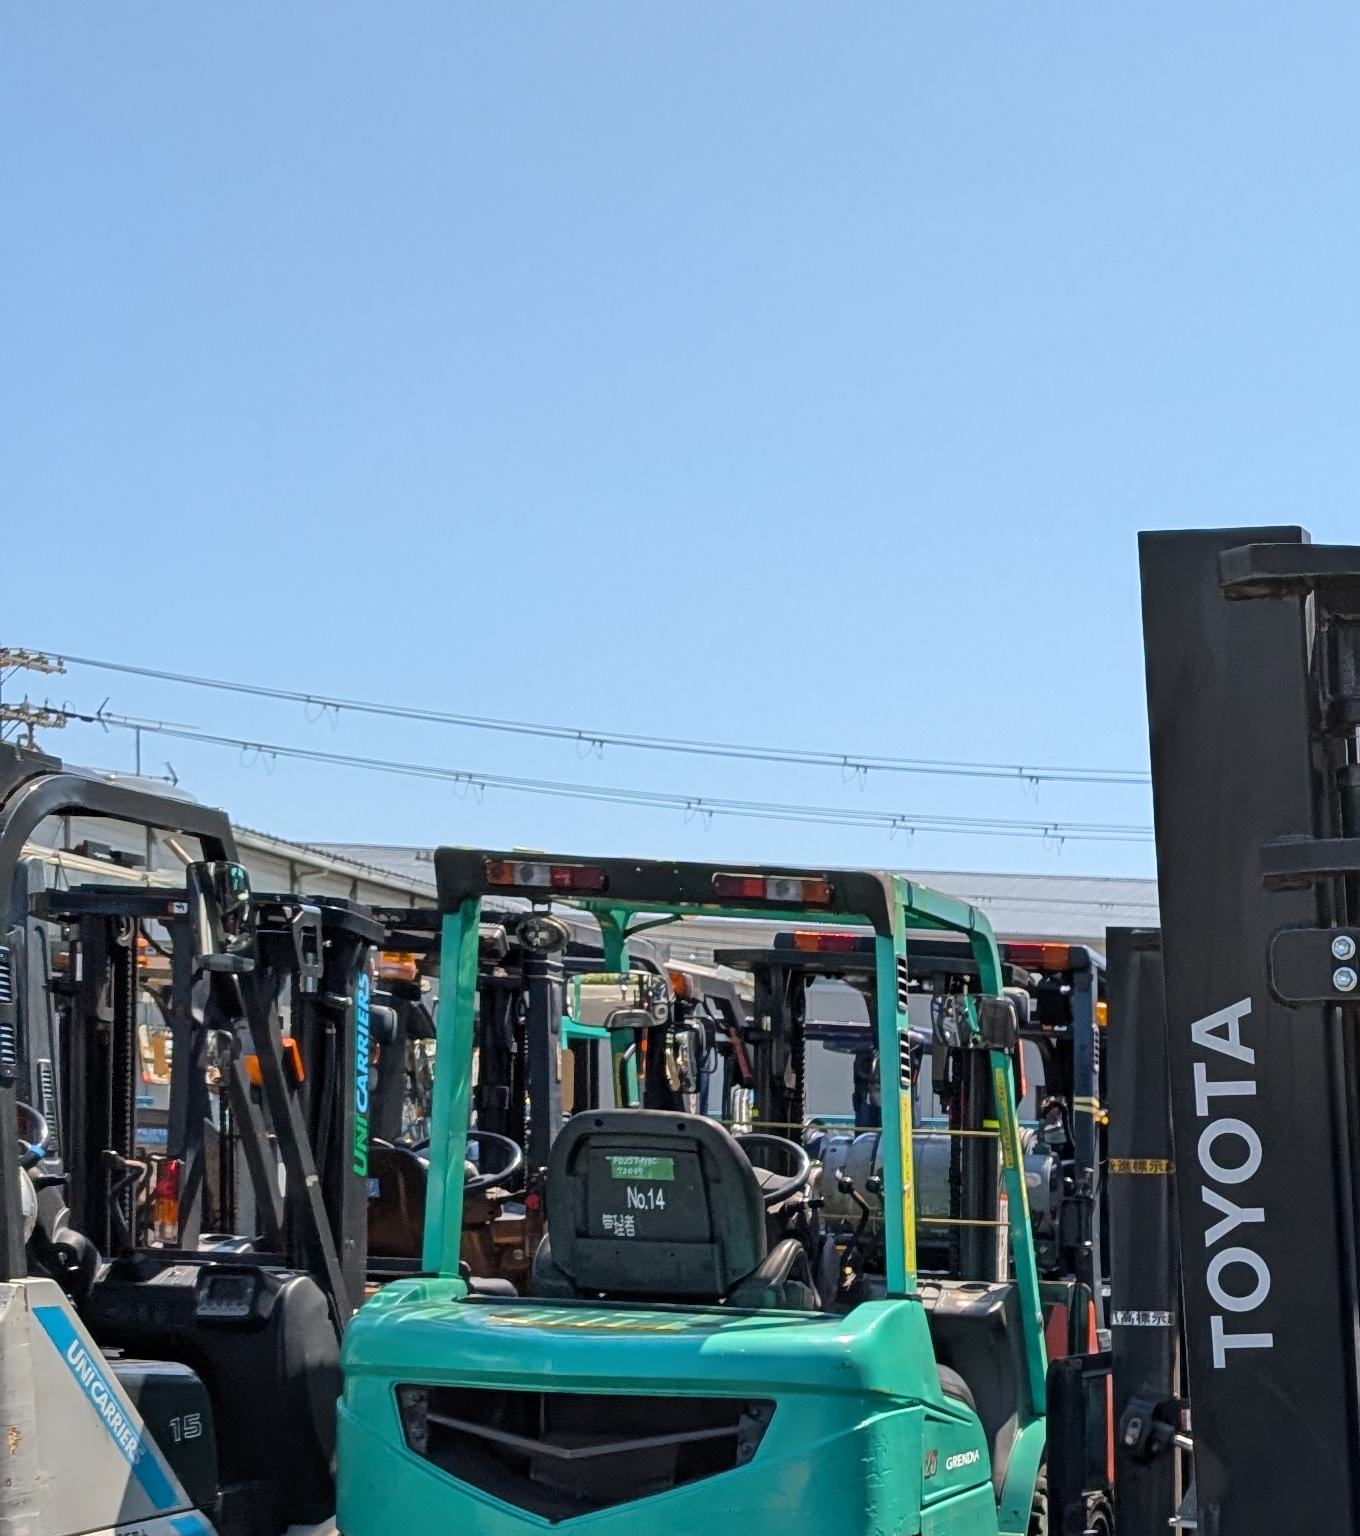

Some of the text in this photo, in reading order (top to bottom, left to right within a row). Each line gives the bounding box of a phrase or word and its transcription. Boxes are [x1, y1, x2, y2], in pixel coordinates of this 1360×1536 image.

[352, 971, 370, 1178] UNICARRIERS
[626, 1185, 666, 1210] No.14
[1190, 996, 1274, 1369] TOYOTA
[67, 1338, 145, 1464] UNICARRIERS
[169, 1412, 203, 1443] 15
[945, 1449, 980, 1471] GRENDIA
